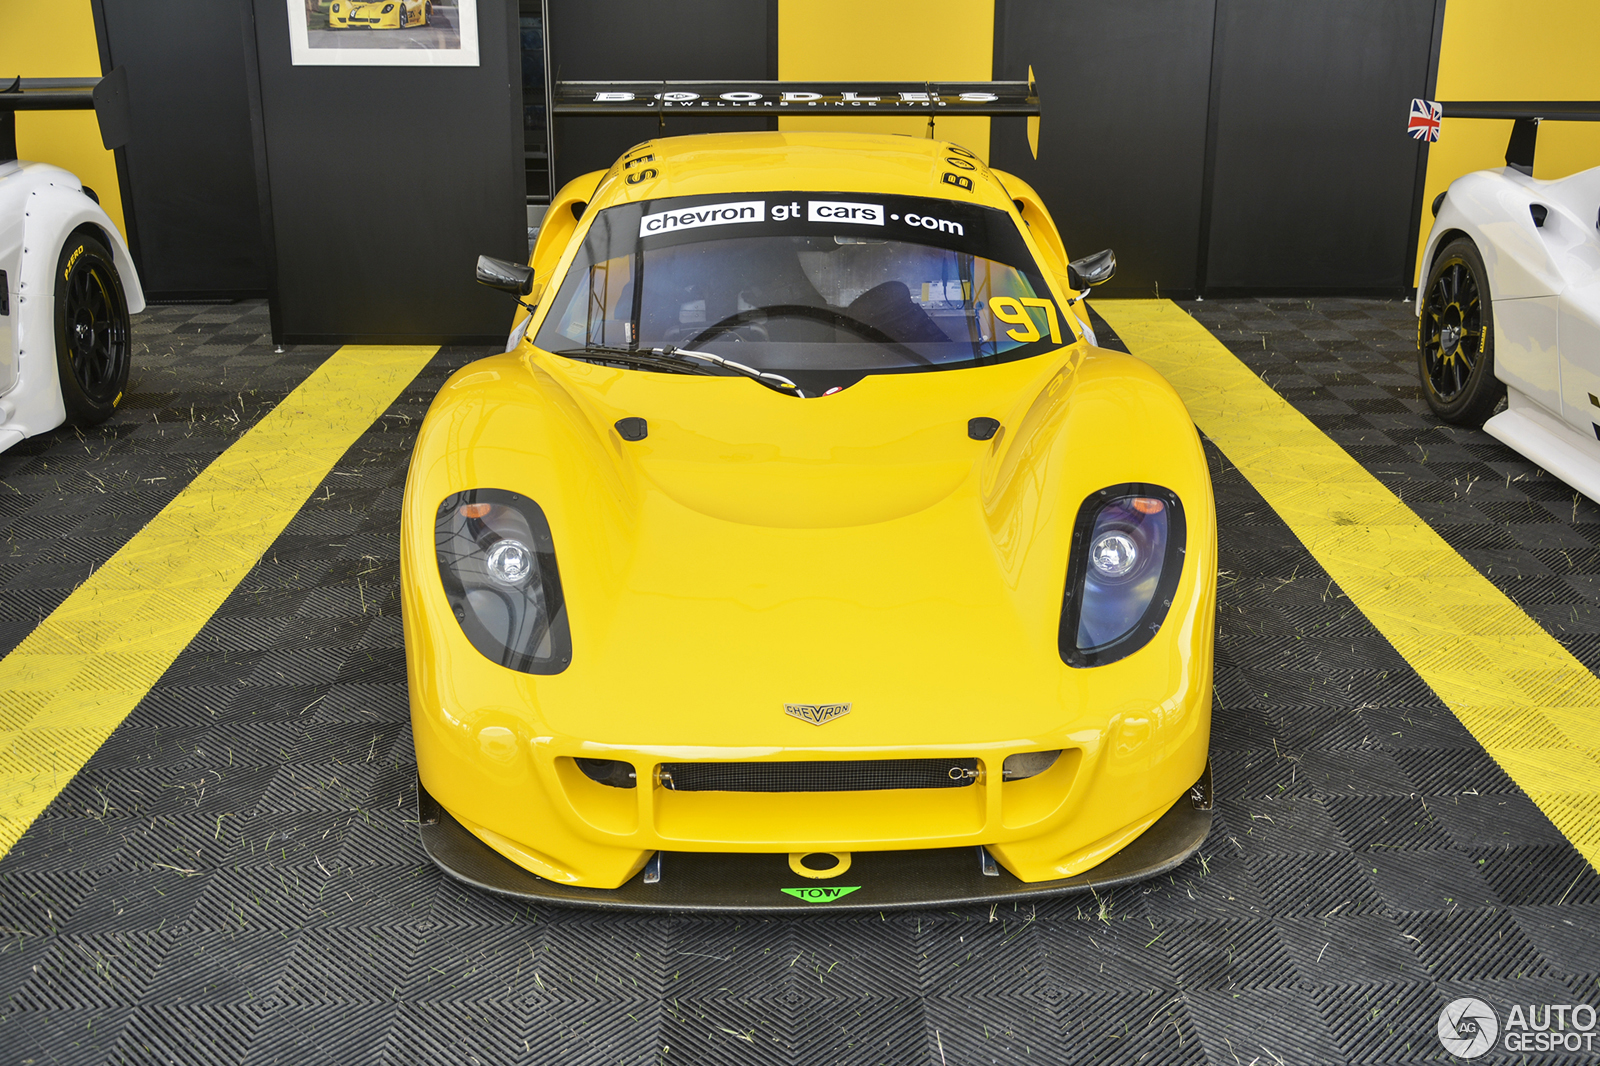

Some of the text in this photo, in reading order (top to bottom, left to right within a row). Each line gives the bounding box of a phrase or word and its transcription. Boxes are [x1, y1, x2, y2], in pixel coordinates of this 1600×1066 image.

[593, 91, 999, 102] BOODLES
[645, 203, 756, 232] chevron
[770, 202, 801, 221] gt
[816, 204, 877, 221] cars
[988, 296, 1063, 345] 97
[786, 704, 849, 722] CHEVRON
[796, 888, 842, 898] TOW
